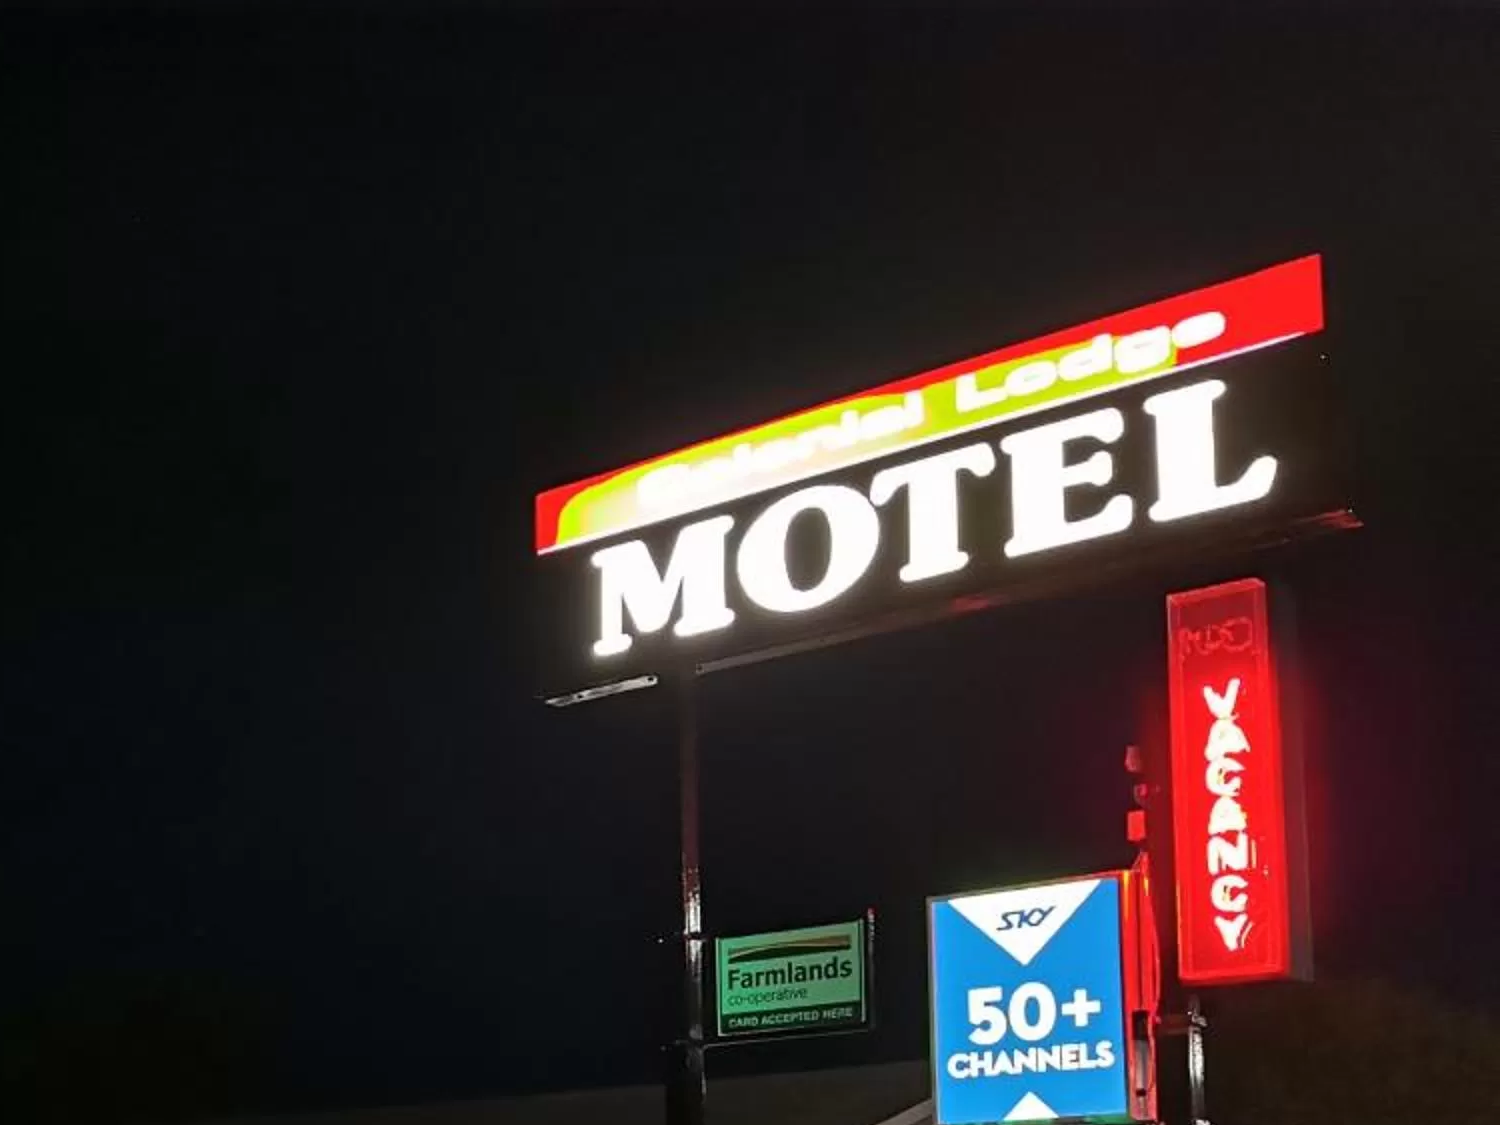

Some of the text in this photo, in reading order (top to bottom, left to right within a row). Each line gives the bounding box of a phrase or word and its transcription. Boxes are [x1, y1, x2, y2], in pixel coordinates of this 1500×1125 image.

[956, 311, 1226, 413] Lodge
[591, 378, 1279, 658] MOTEL
[1203, 677, 1253, 952] VACANCY
[997, 905, 1056, 931] SKY
[728, 956, 852, 990] Farmlands
[728, 1006, 853, 1029] CARD ACCEPTED HERE
[967, 981, 1102, 1045] 50+
[947, 1040, 1115, 1079] CHANNELS
